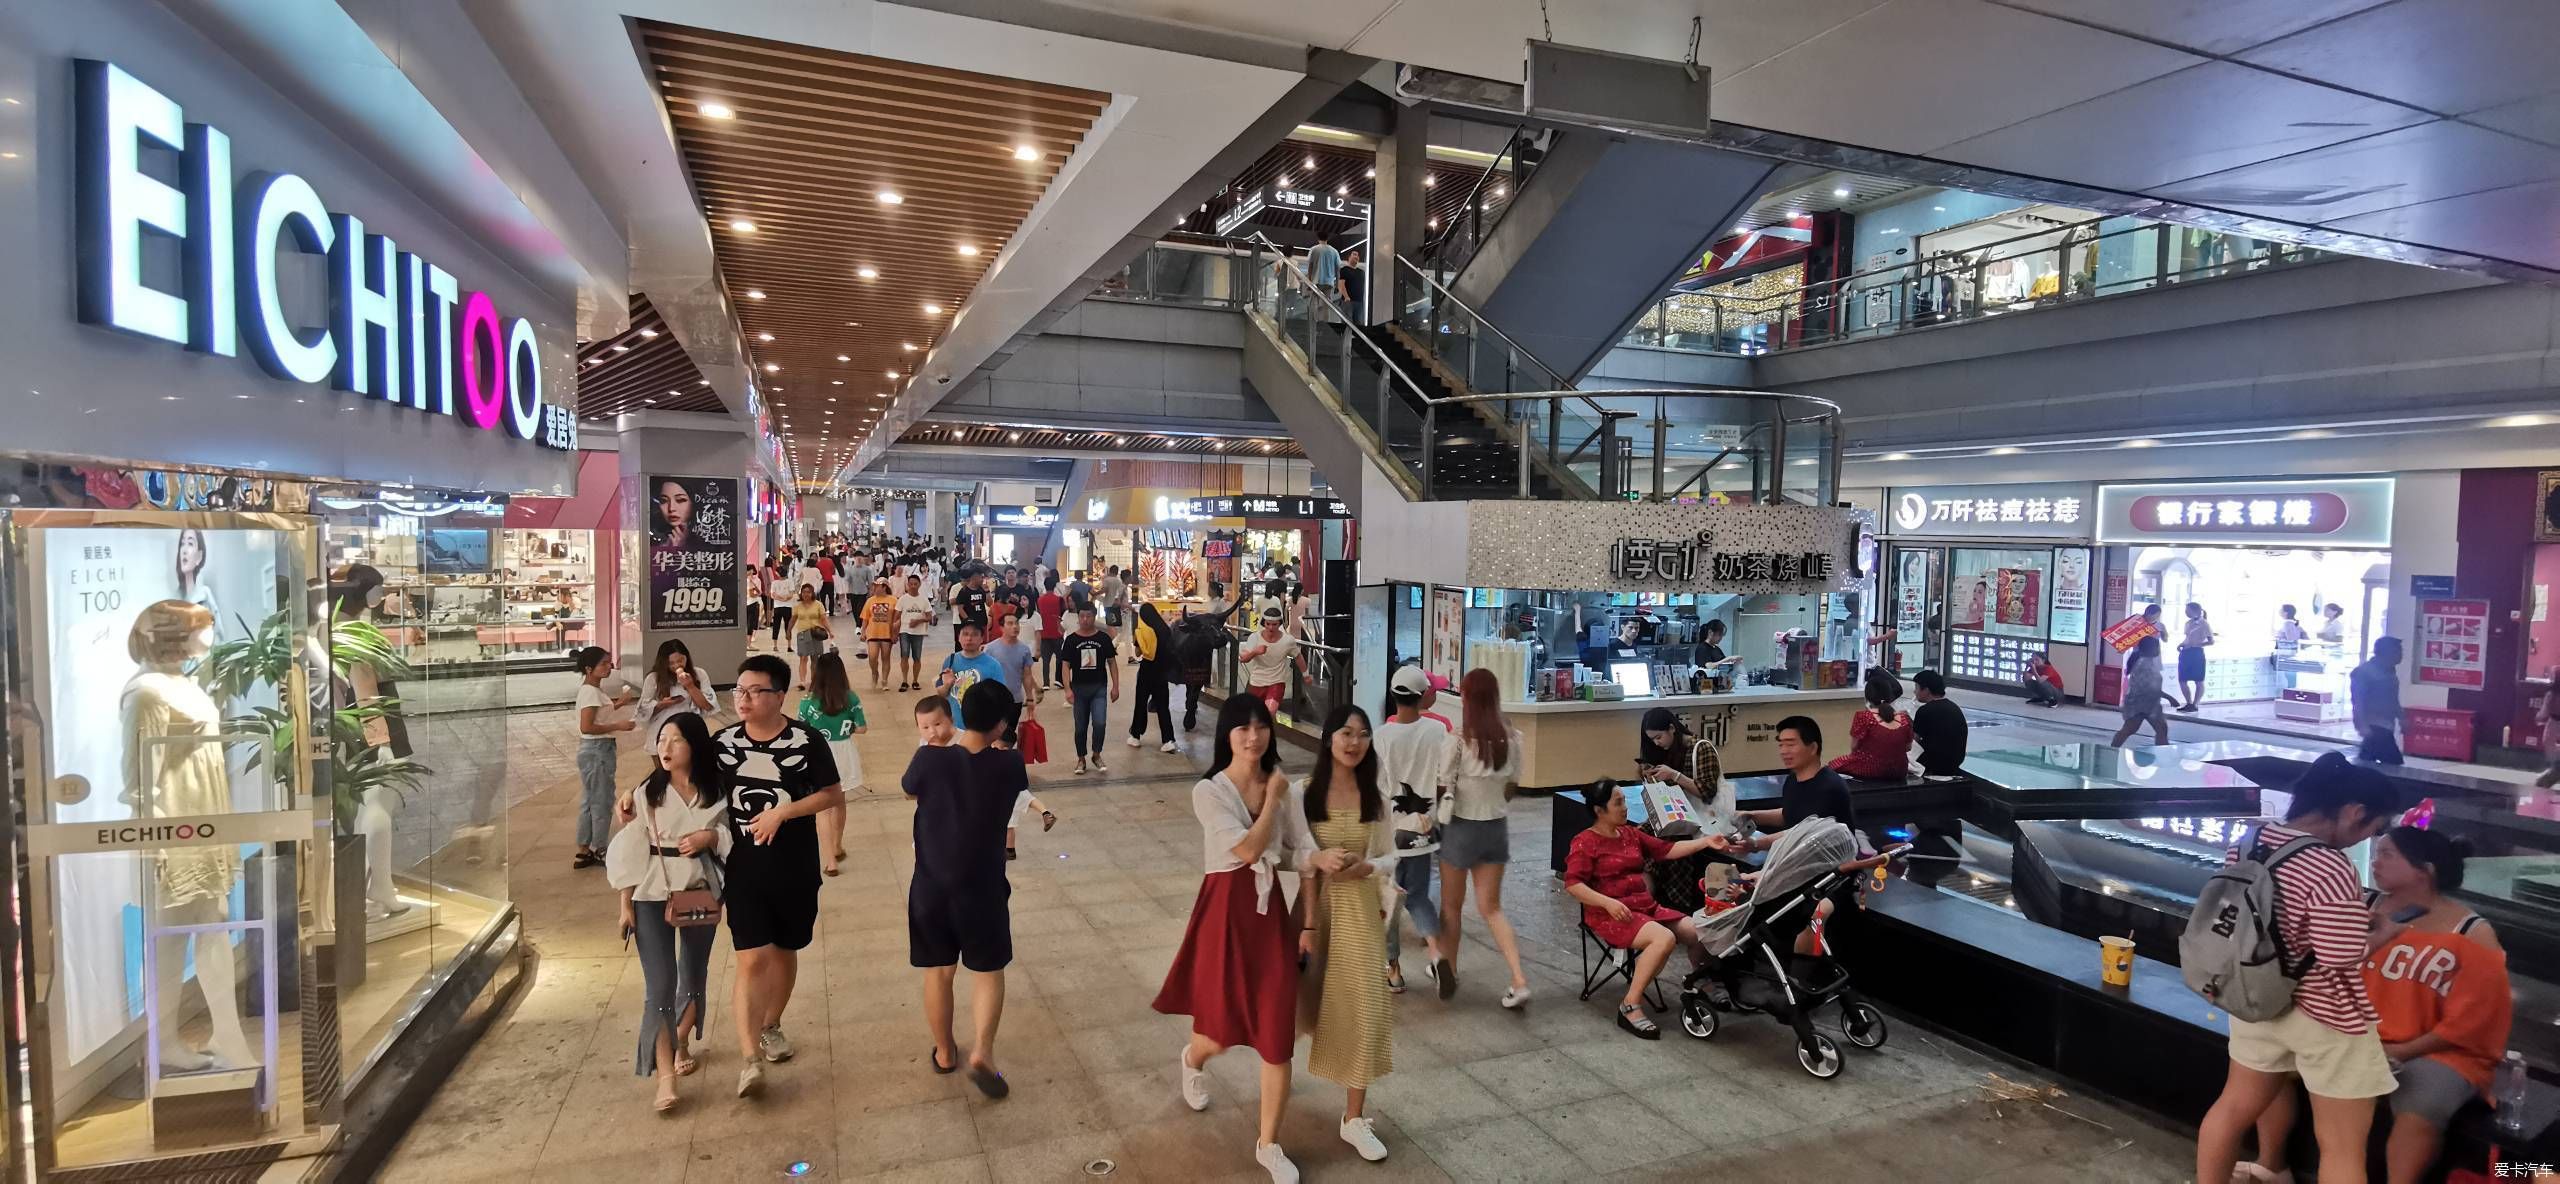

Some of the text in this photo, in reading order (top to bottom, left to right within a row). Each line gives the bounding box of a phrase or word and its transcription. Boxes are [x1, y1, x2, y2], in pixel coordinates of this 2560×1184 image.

[1327, 196, 1345, 212] L2
[75, 59, 541, 440] EICHITOO
[546, 404, 577, 451] 爱居兔
[694, 493, 729, 504] Dream
[1299, 501, 1313, 515] L1
[1931, 497, 2079, 523] 万阡祛痘祛痣
[652, 551, 734, 571] 华美整形
[71, 566, 125, 584] EICHI
[678, 577, 711, 588] 眼综合
[80, 590, 121, 613] TOO
[662, 587, 724, 613] 1999
[97, 823, 216, 845] EICHITOO
